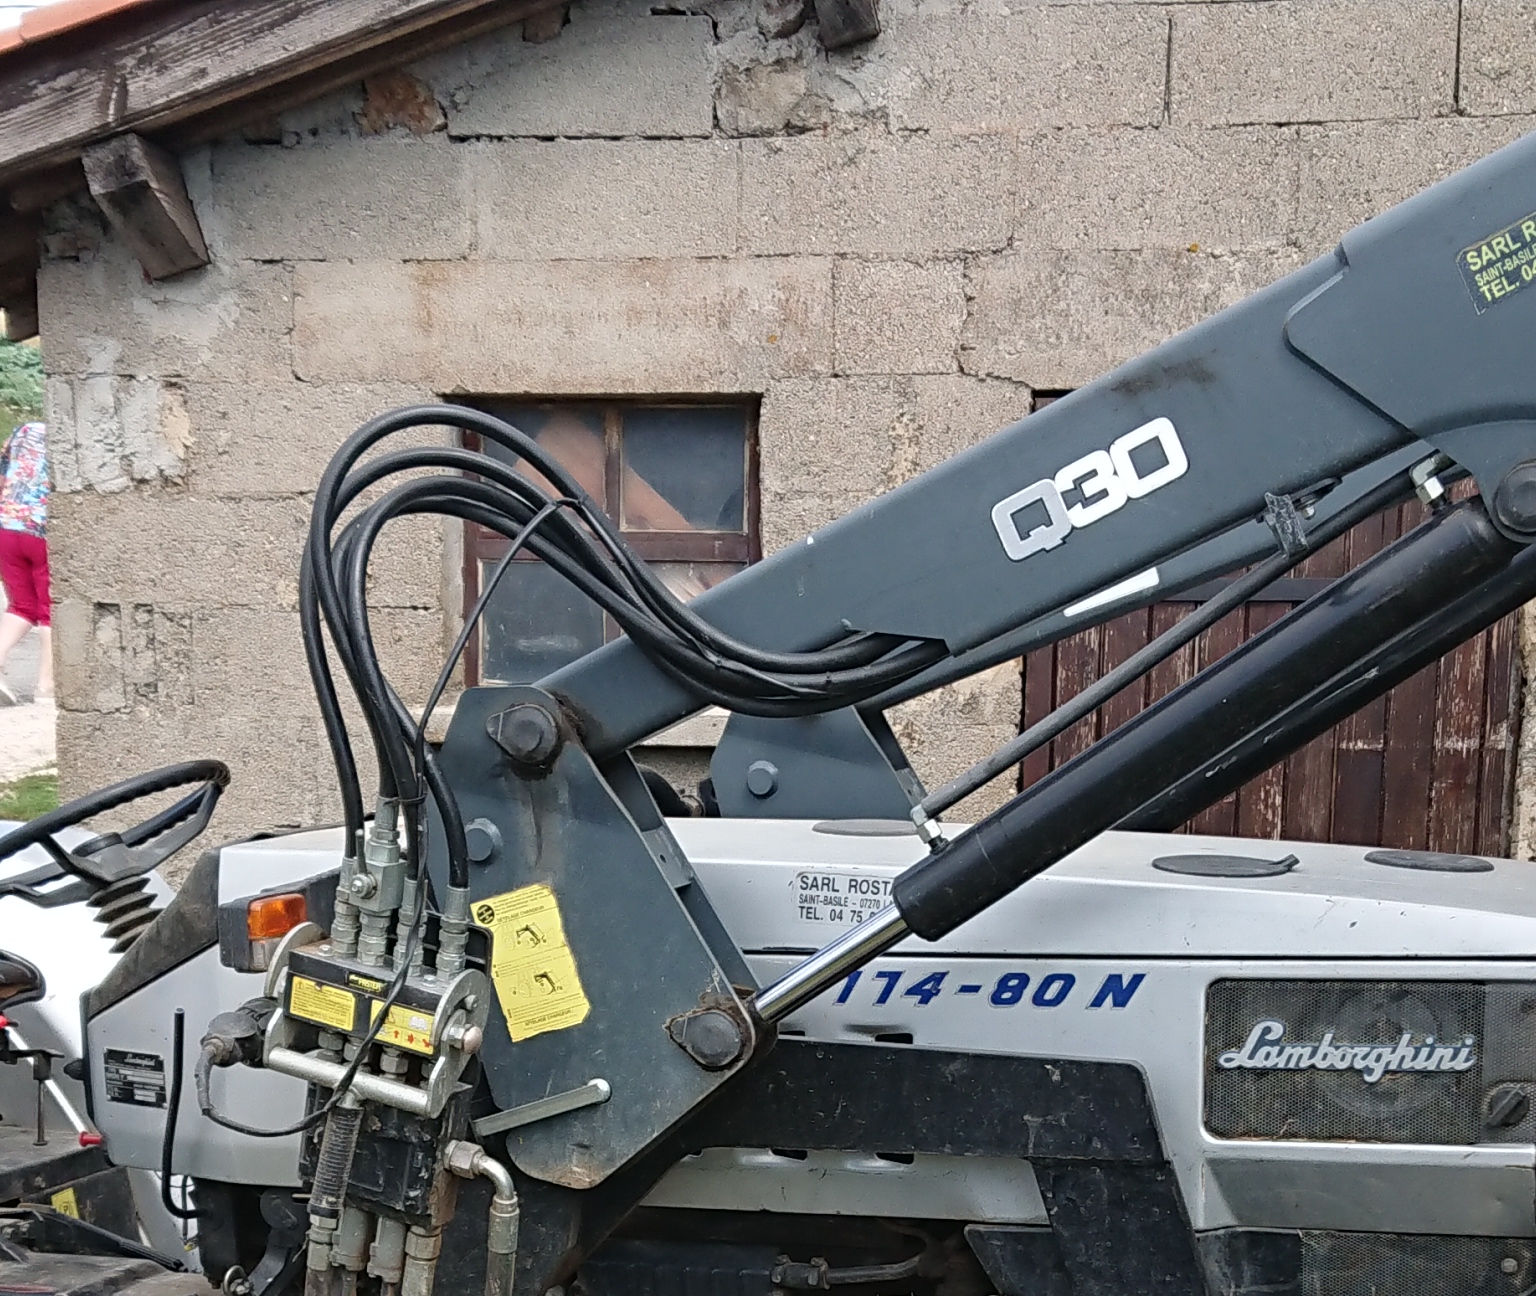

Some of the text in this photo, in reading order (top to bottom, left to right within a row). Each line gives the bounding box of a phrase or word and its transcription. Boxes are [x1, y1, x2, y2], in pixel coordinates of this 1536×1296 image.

[1466, 236, 1522, 271] SARL
[1479, 277, 1520, 302] TEL.
[991, 416, 1189, 562] Q30
[799, 875, 894, 896] SARL ROST
[798, 906, 823, 920] TEL.
[829, 909, 843, 922] 04
[849, 909, 863, 923] 75
[799, 893, 849, 907] SAINT-BASILE
[859, 898, 881, 909] 07270
[1087, 973, 1147, 1008] N
[1219, 1020, 1476, 1083] Lamborghini
